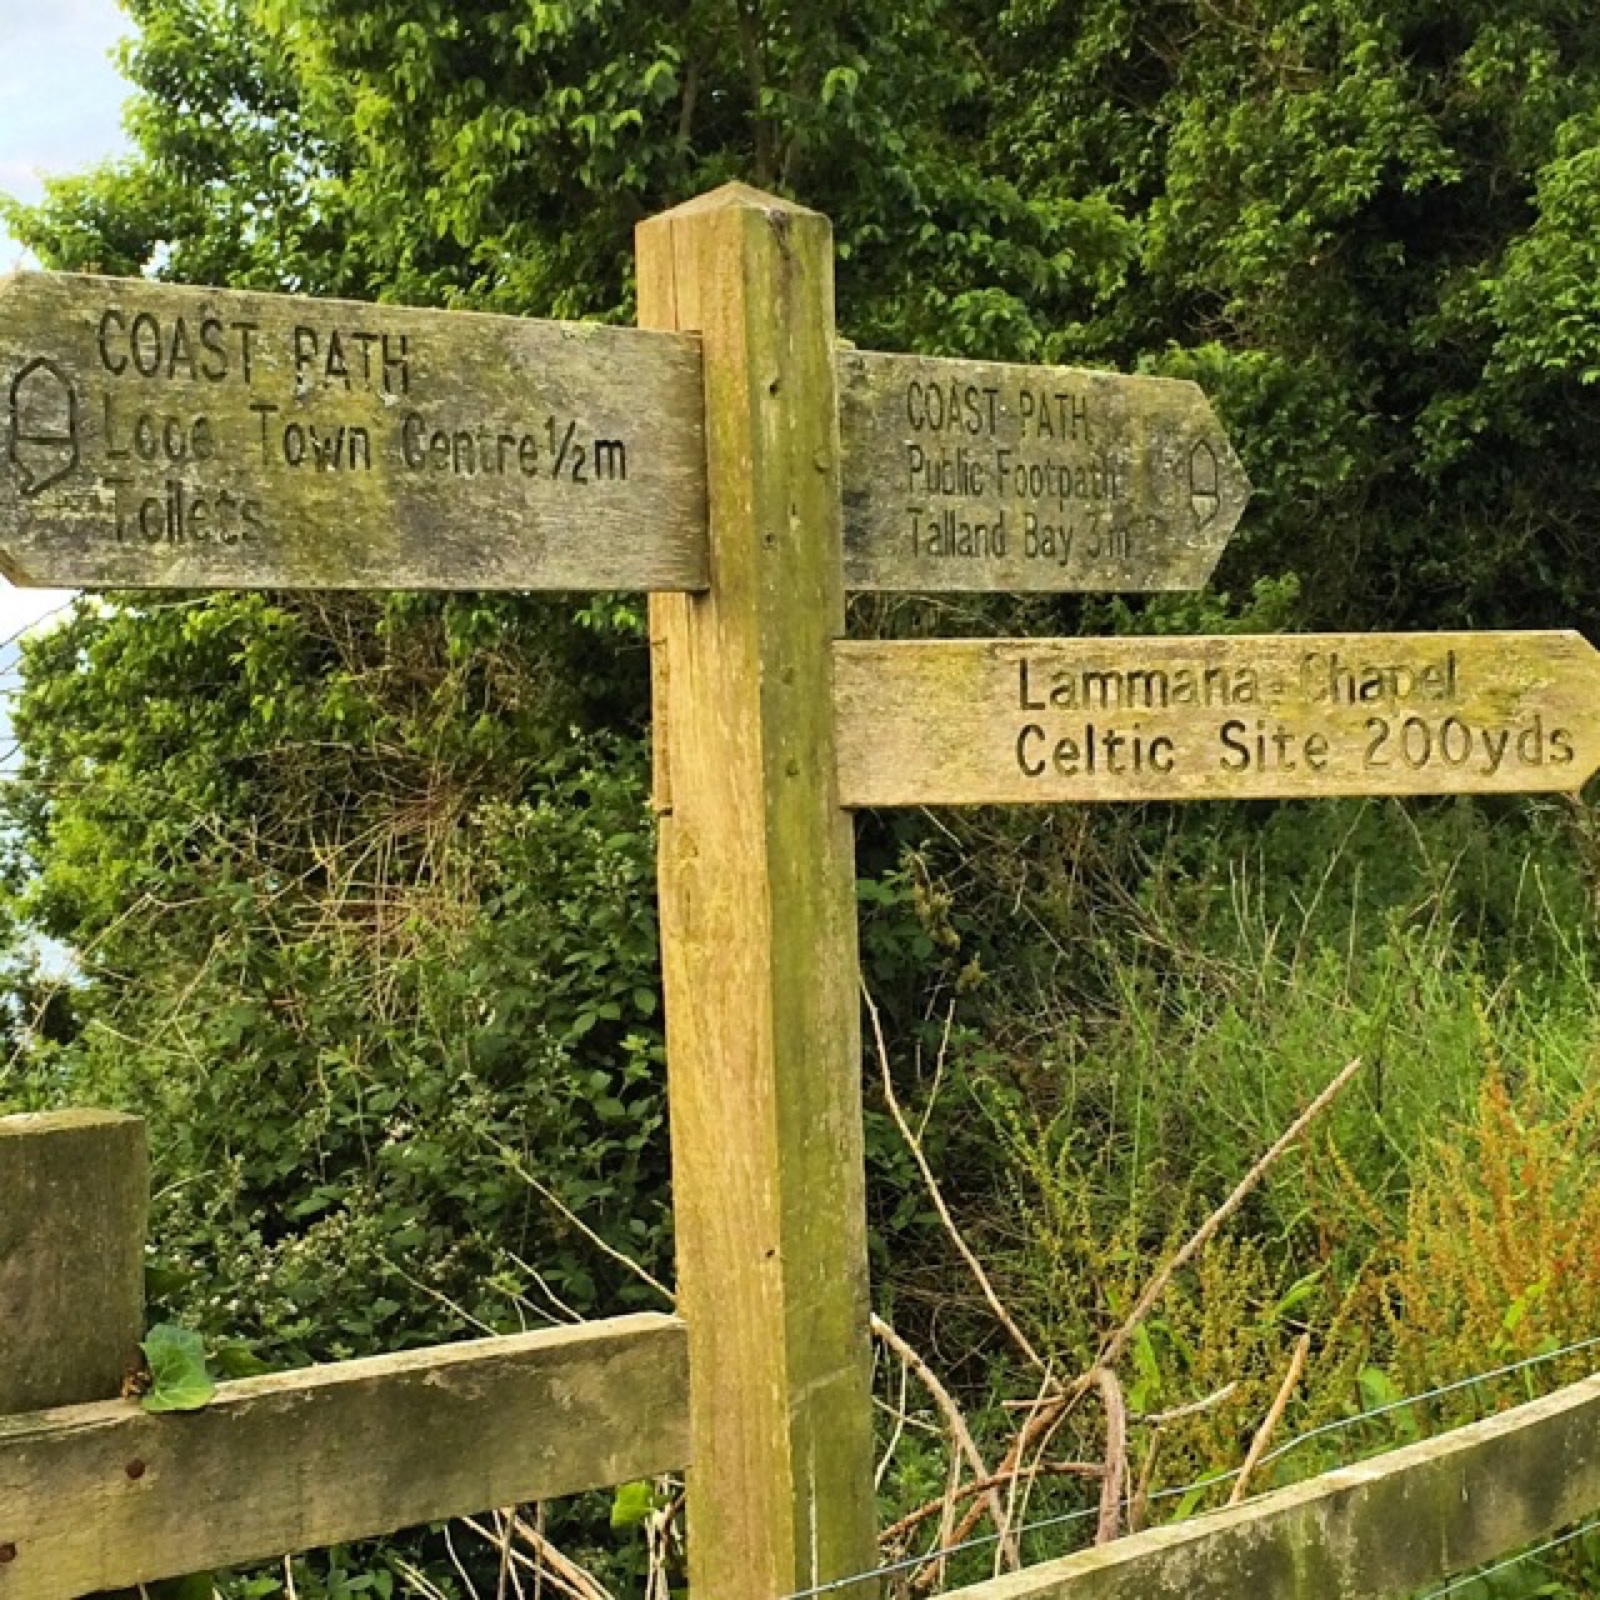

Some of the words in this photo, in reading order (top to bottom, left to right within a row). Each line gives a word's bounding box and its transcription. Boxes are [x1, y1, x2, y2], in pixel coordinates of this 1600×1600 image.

[99, 309, 258, 383] COAST
[293, 325, 409, 401] PATH
[103, 393, 213, 460] Looe
[249, 403, 372, 472] Town
[402, 411, 538, 478] Centre
[906, 378, 999, 436] COAST
[1020, 389, 1089, 442] PATH
[906, 443, 985, 498] Public
[998, 450, 1121, 512] Footpath
[103, 478, 262, 544] Toilets
[906, 506, 1006, 559] Talland
[1024, 512, 1074, 567] Bay
[1019, 657, 1259, 711] Lammana
[1016, 723, 1175, 777] Celtic
[1219, 719, 1329, 772] Site
[1363, 713, 1574, 777] 200yds
